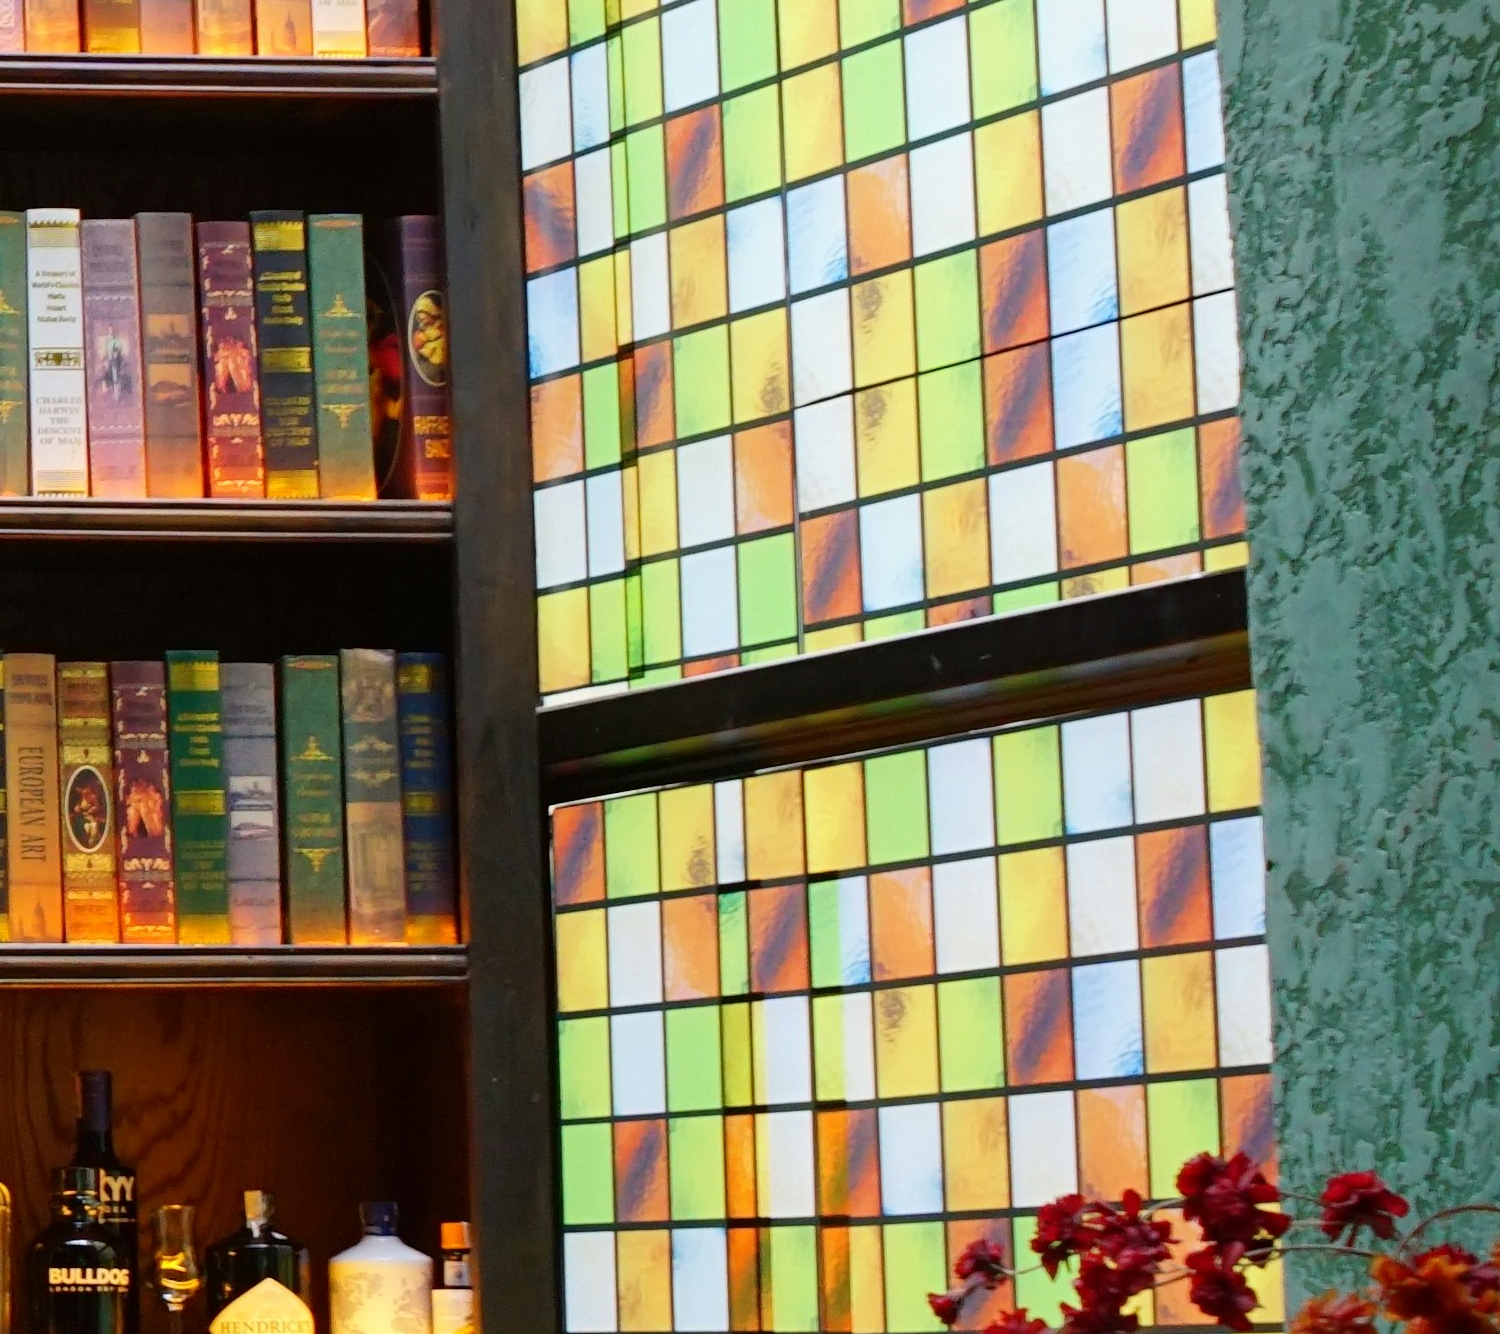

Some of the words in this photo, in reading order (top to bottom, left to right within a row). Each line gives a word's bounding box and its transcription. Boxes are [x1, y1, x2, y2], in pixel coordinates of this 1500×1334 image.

[18, 746, 46, 827] EUROPEAN
[21, 834, 46, 863] ART
[100, 1168, 134, 1202] KYY
[48, 1267, 130, 1285] BULLDOG
